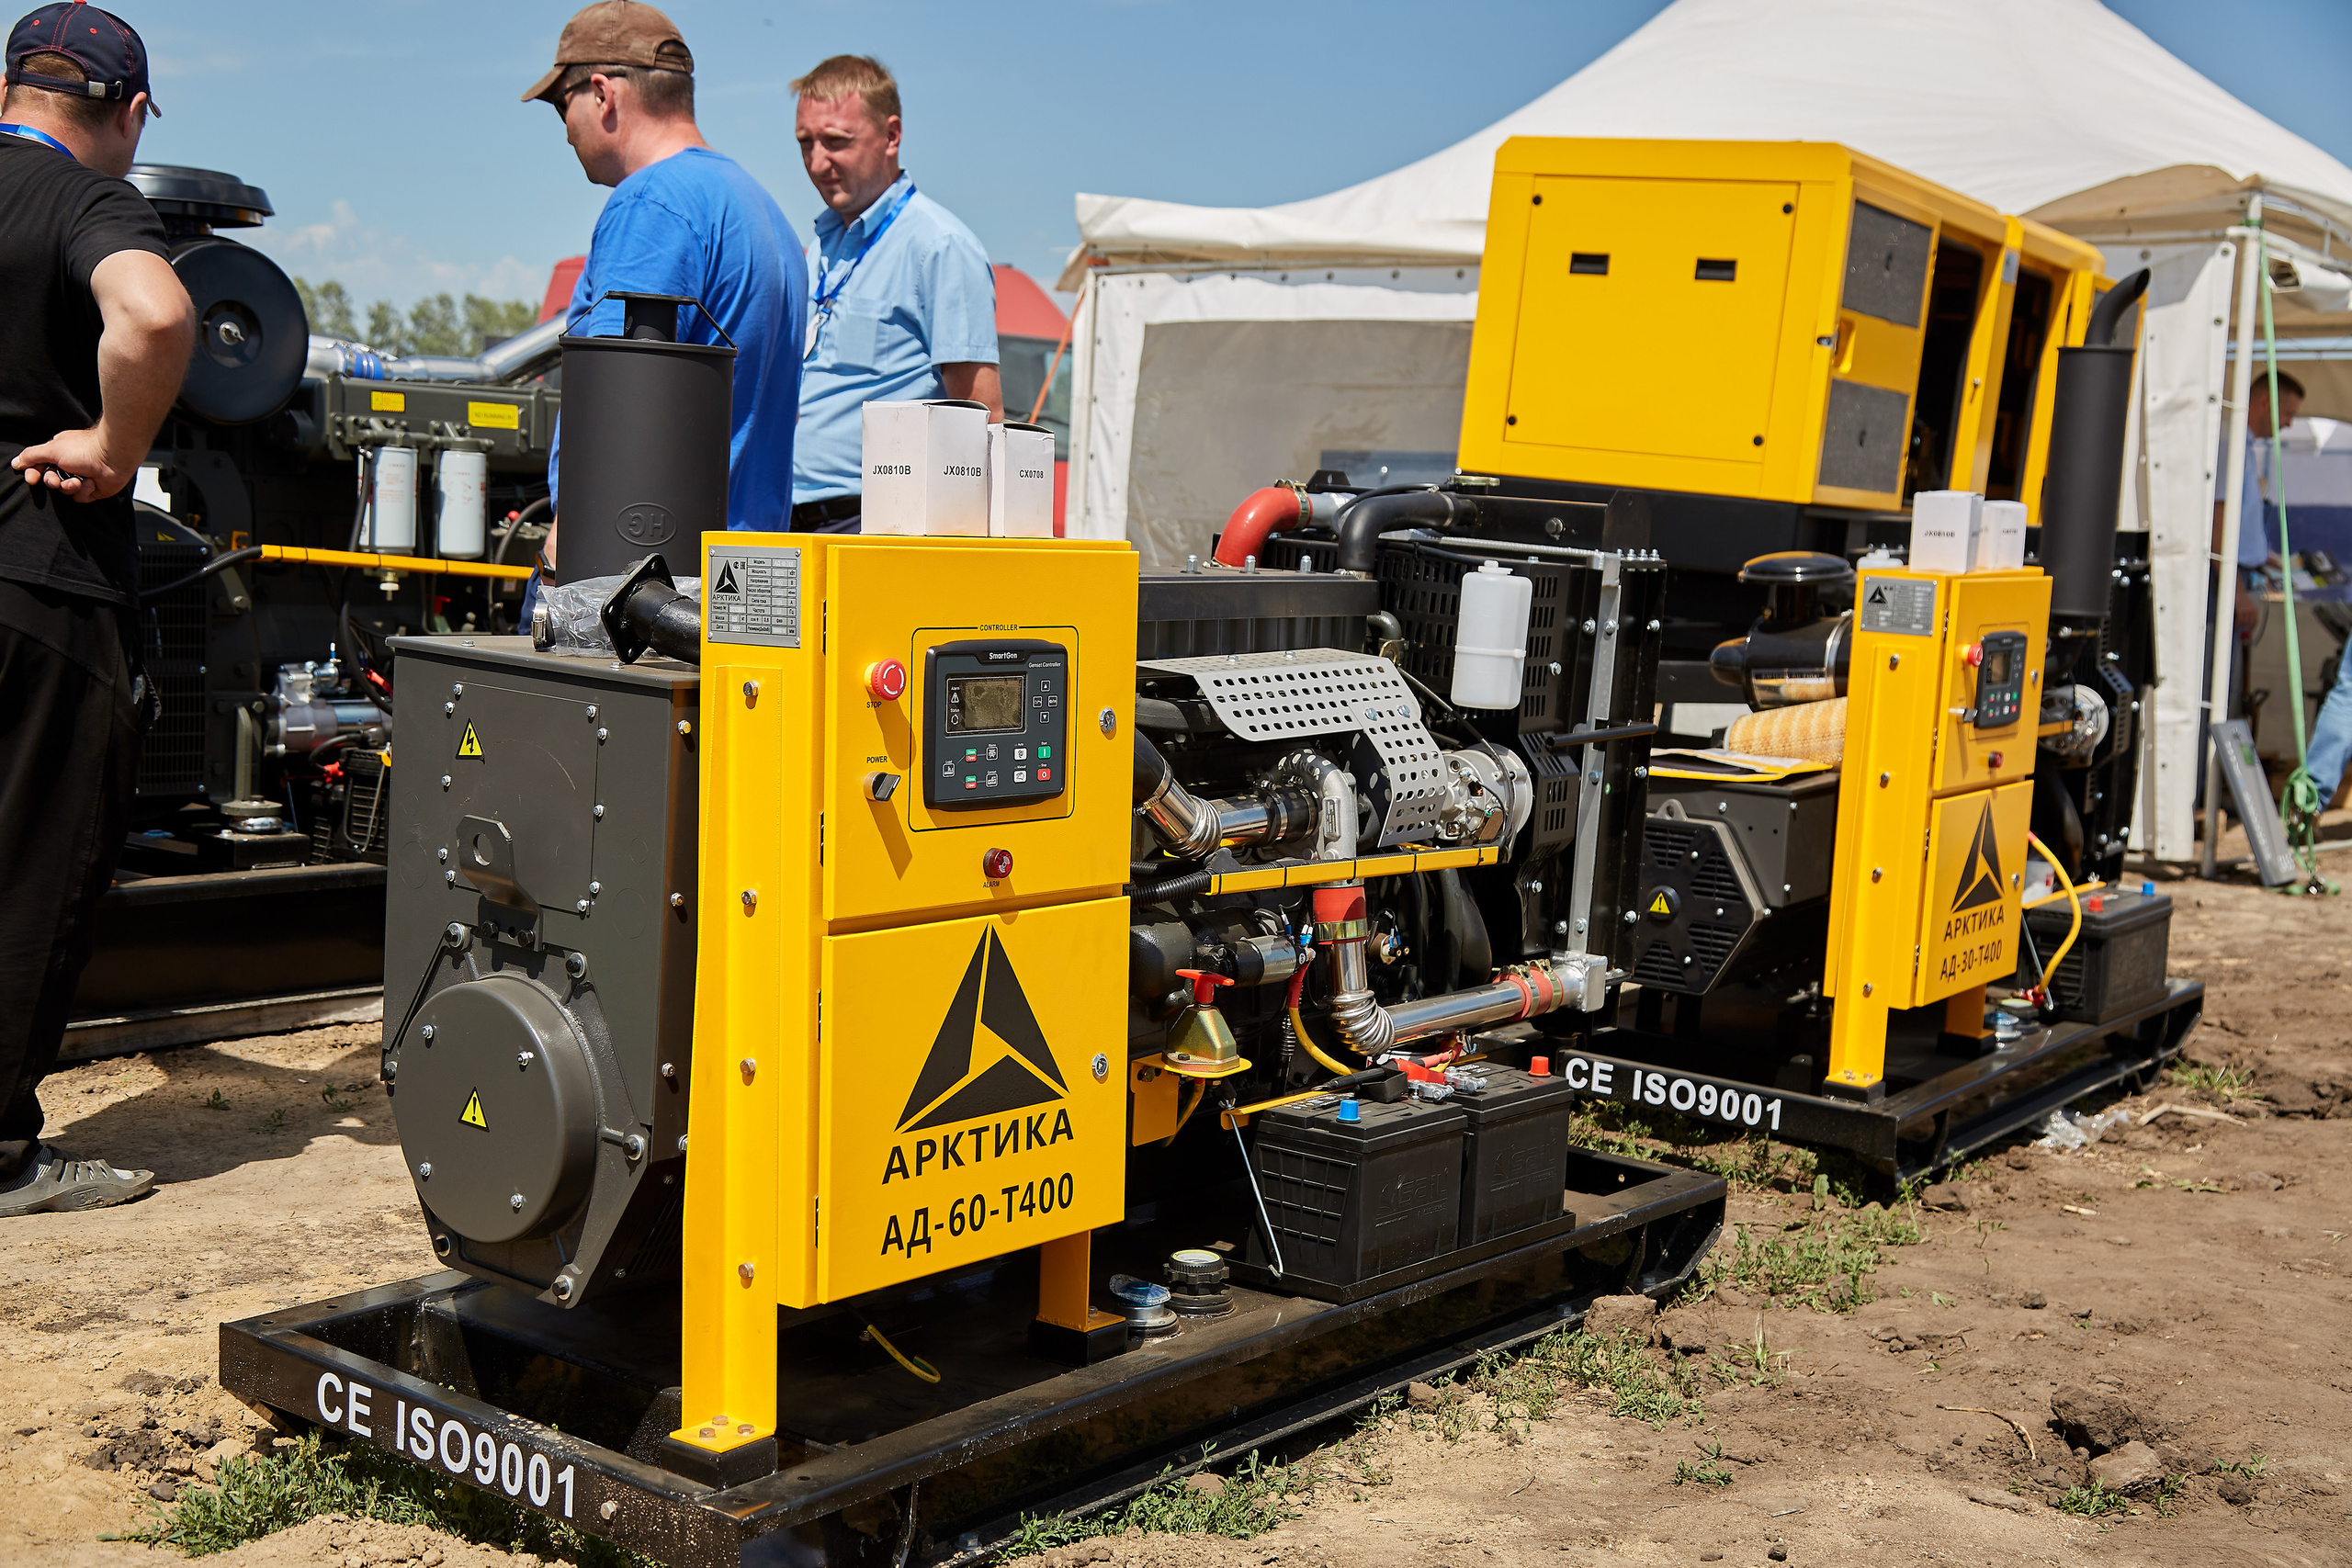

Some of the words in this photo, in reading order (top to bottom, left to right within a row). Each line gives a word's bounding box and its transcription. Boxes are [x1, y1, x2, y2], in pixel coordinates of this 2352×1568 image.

[872, 465, 911, 475] JX0810B
[943, 465, 982, 477] JX0810B
[1019, 469, 1044, 479] CX0708
[1944, 904, 2004, 942] АРКТИКА
[1940, 939, 2002, 983] АД-30-Т400
[1565, 1057, 1614, 1095] CE
[1632, 1069, 1781, 1130] ISO9001
[882, 1108, 1074, 1185] АРКТИКА
[880, 1172, 1074, 1259] АД-60-Т400
[317, 1372, 372, 1438] CE
[396, 1399, 575, 1518] ISO9001
